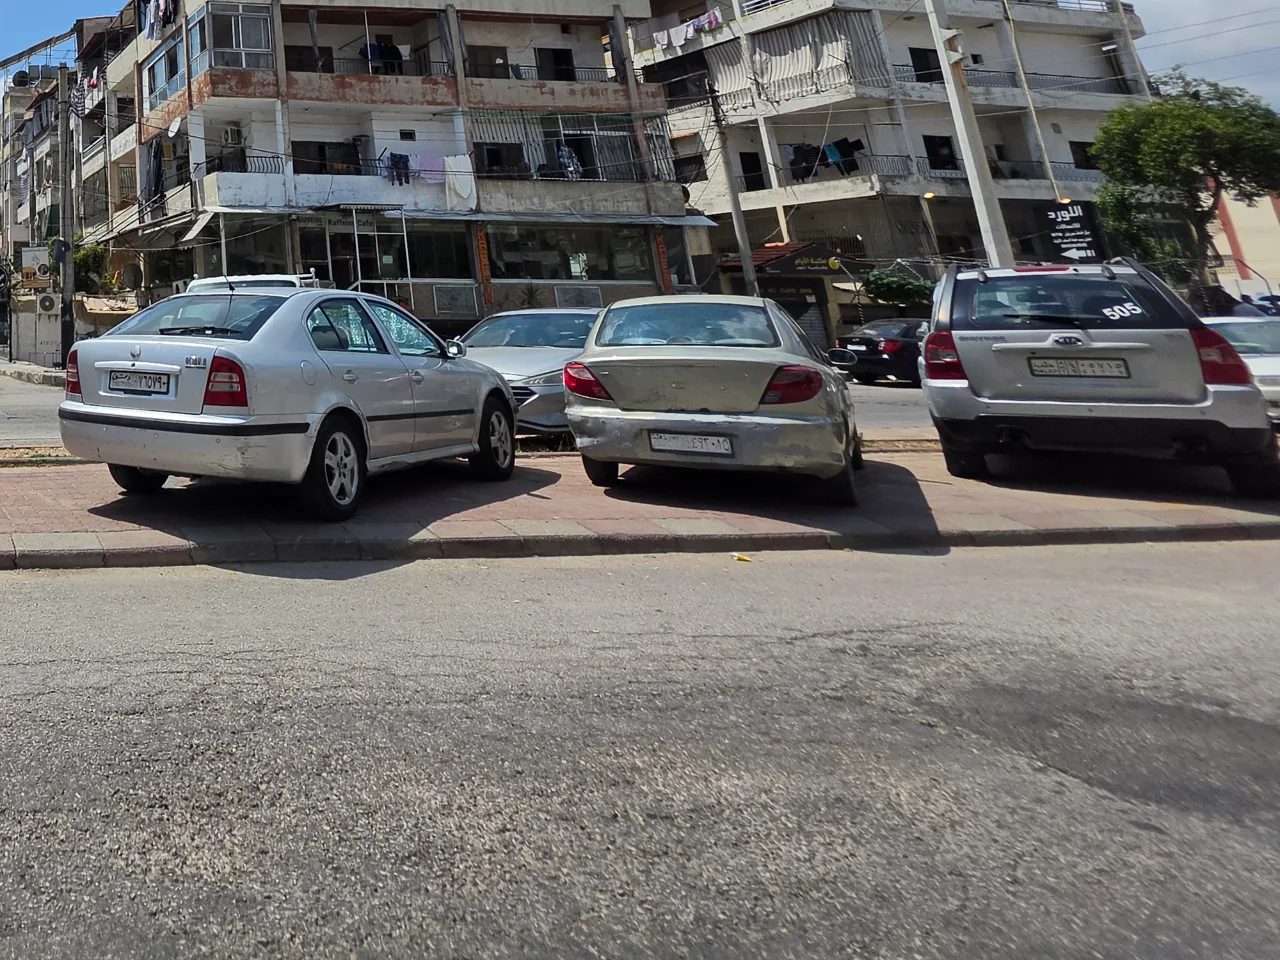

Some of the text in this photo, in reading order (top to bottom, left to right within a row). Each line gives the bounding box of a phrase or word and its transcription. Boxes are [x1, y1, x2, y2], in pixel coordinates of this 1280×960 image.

[1047, 205, 1083, 222] اللورد
[357, 219, 373, 227] Cafe
[1102, 302, 1142, 321] 505
